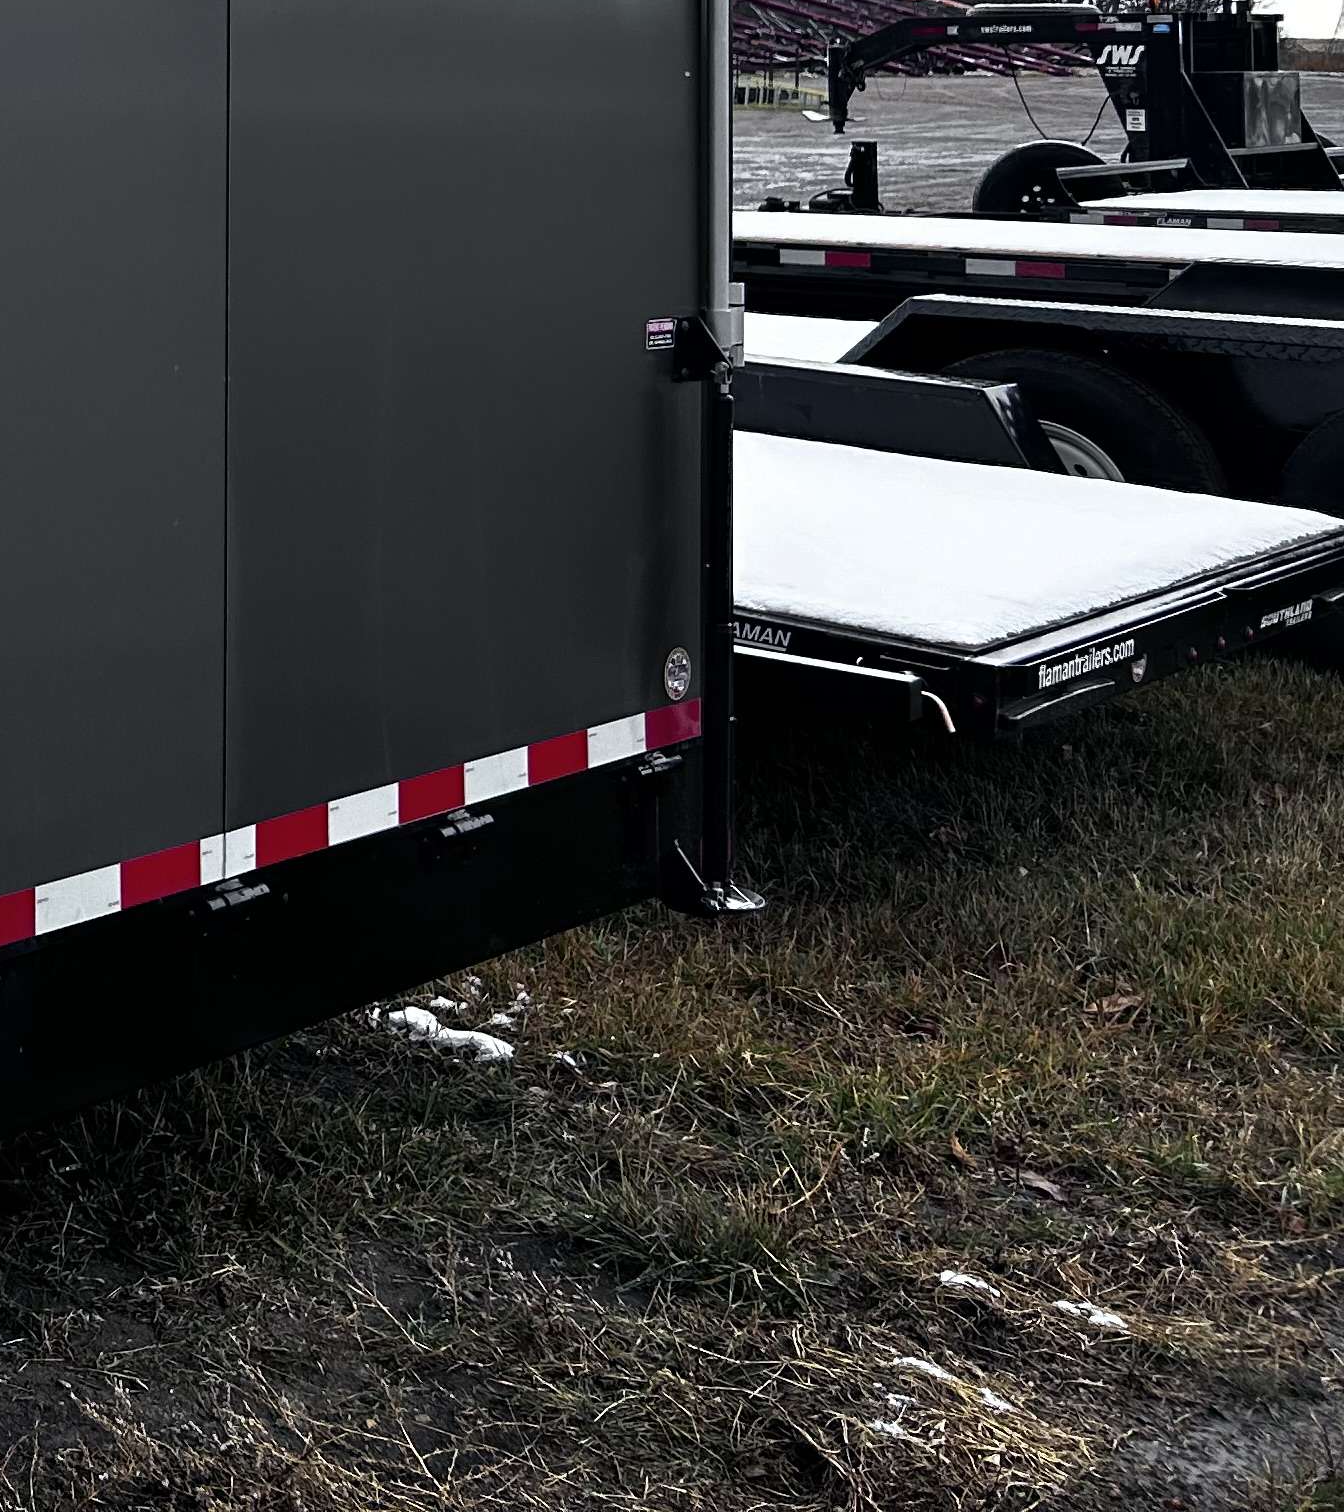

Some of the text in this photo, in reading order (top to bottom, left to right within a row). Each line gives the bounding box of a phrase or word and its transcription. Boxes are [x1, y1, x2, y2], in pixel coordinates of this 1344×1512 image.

[1096, 45, 1145, 65] SWS
[733, 621, 792, 647] AMAN
[1038, 638, 1135, 689] flamantrailers.com
